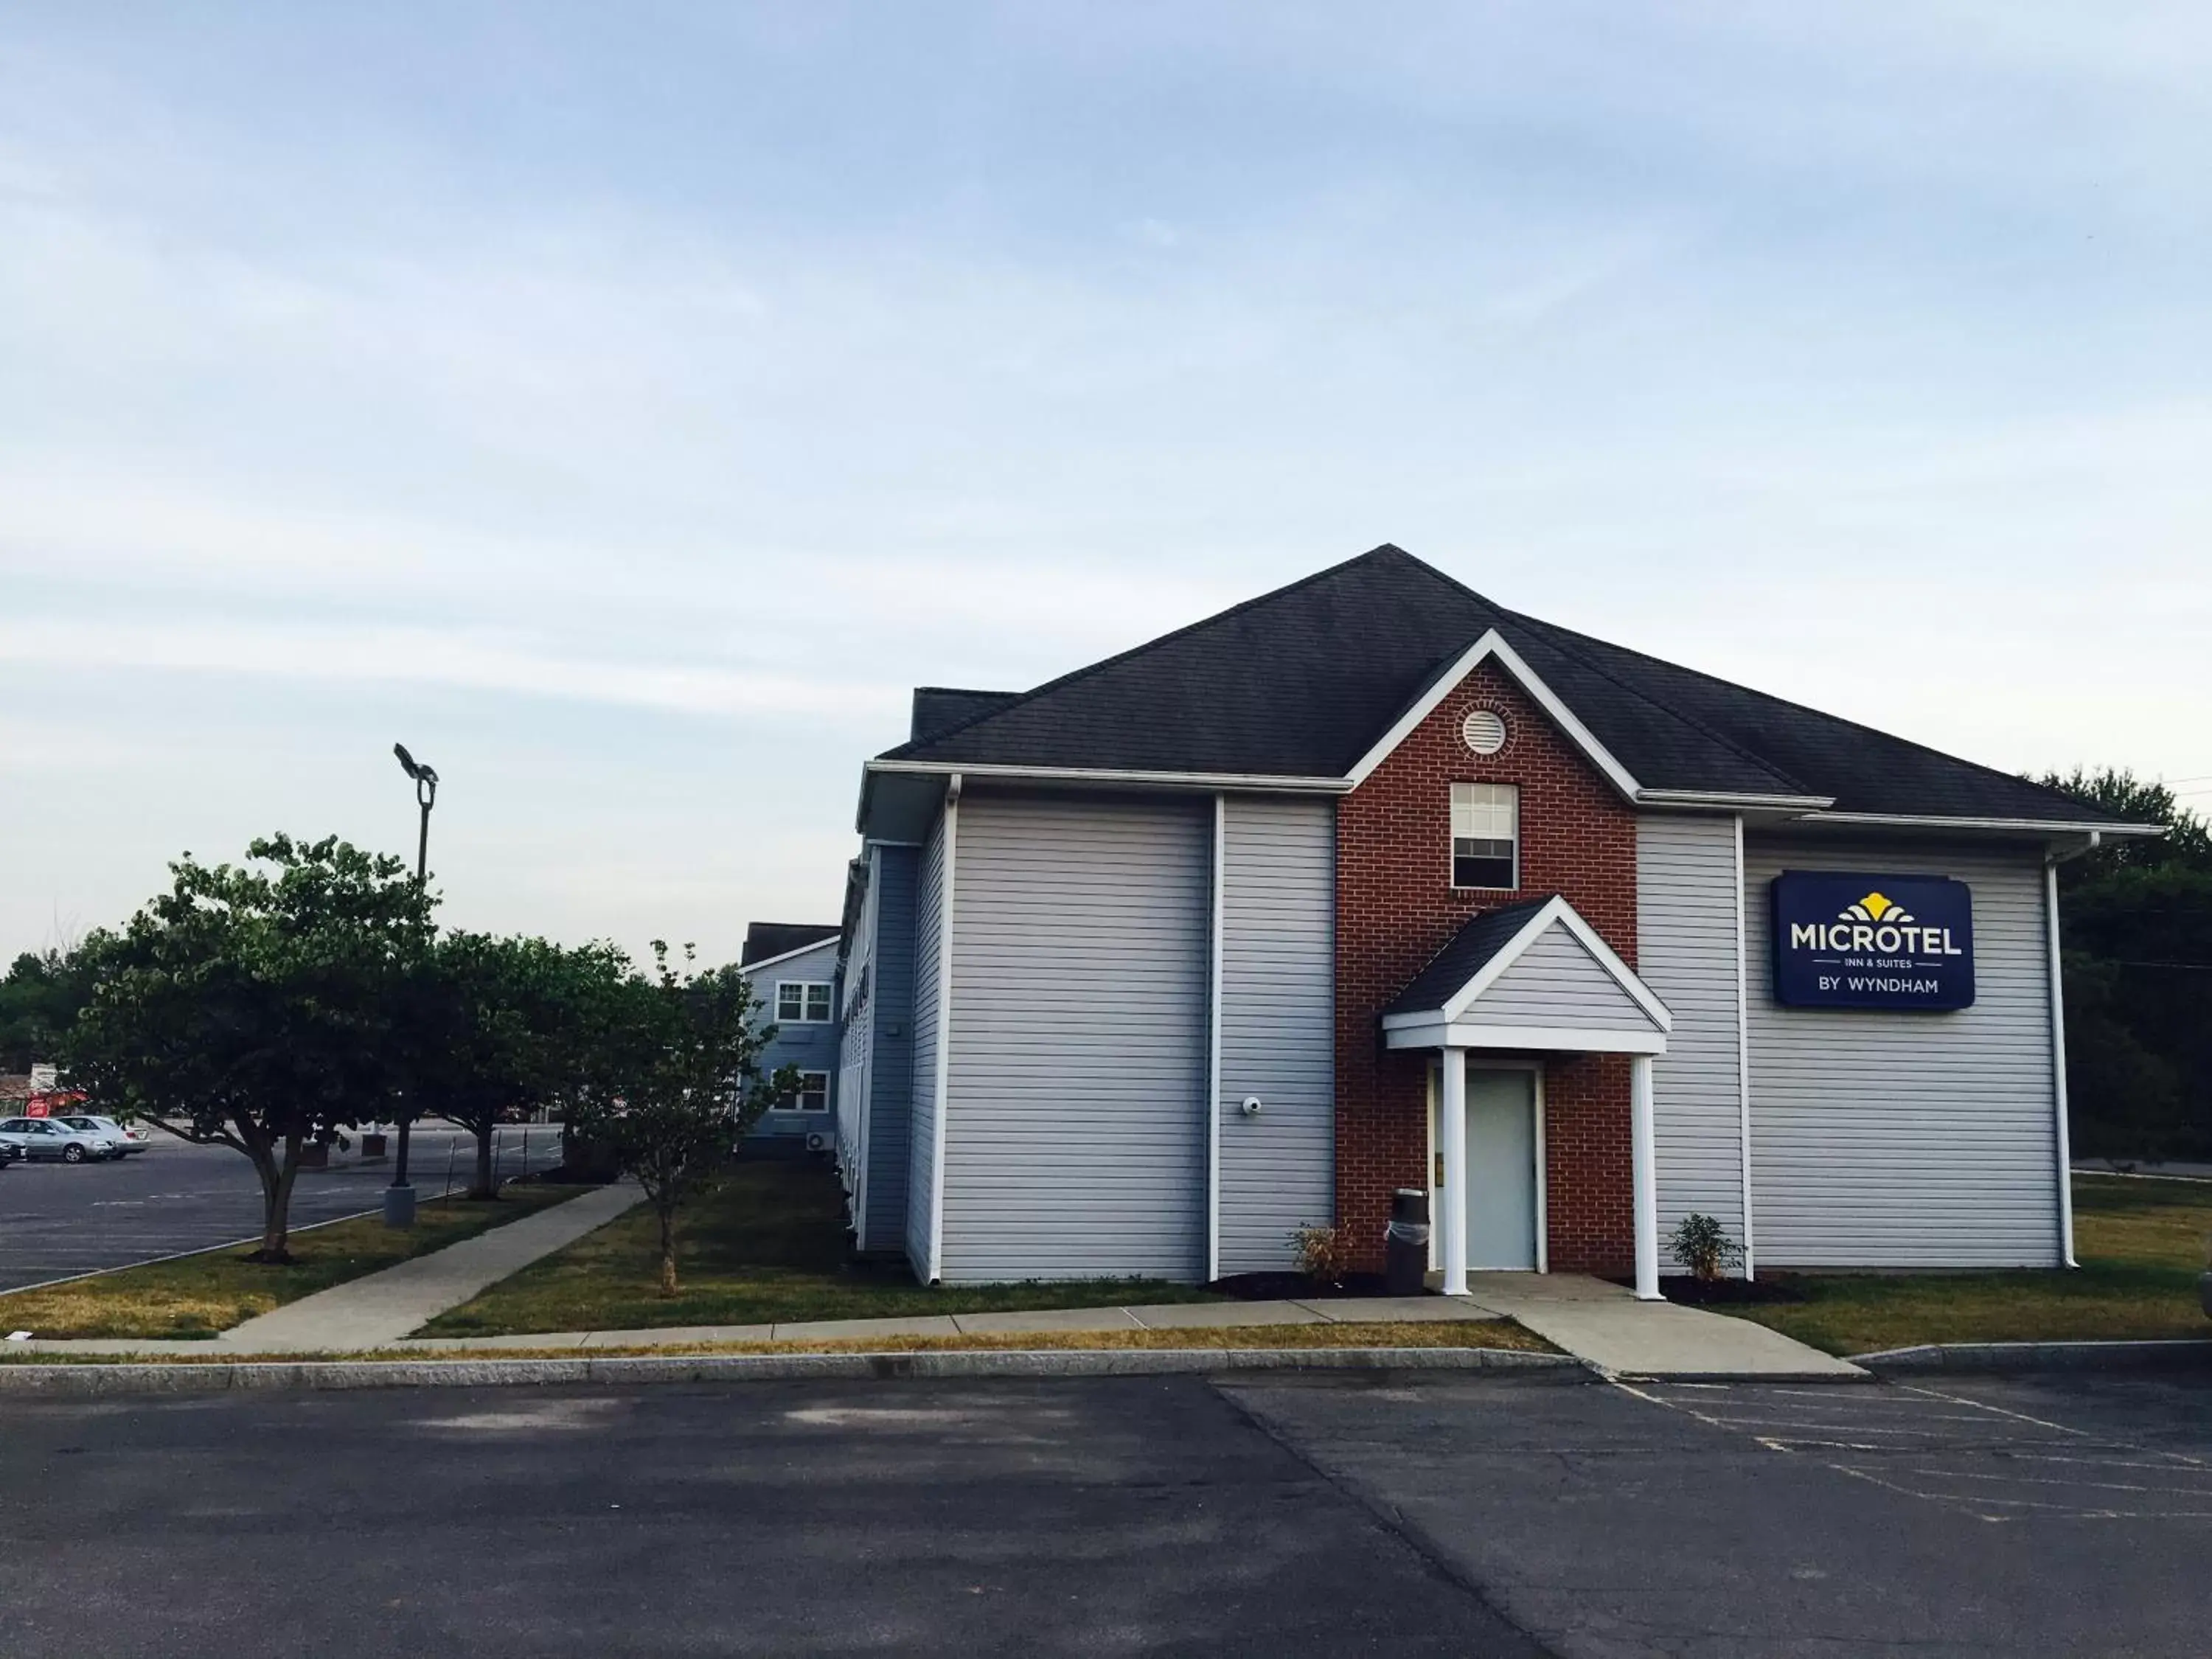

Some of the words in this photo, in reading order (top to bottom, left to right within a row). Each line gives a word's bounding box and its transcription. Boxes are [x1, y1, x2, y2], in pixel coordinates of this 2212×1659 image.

[1790, 922, 1962, 955] MICROTEL
[1844, 958, 1864, 967] INN
[1866, 959, 1874, 967] &
[1877, 959, 1912, 968] SUITES
[1819, 976, 1841, 990] BY
[1848, 977, 1938, 993] WYNDHAM
